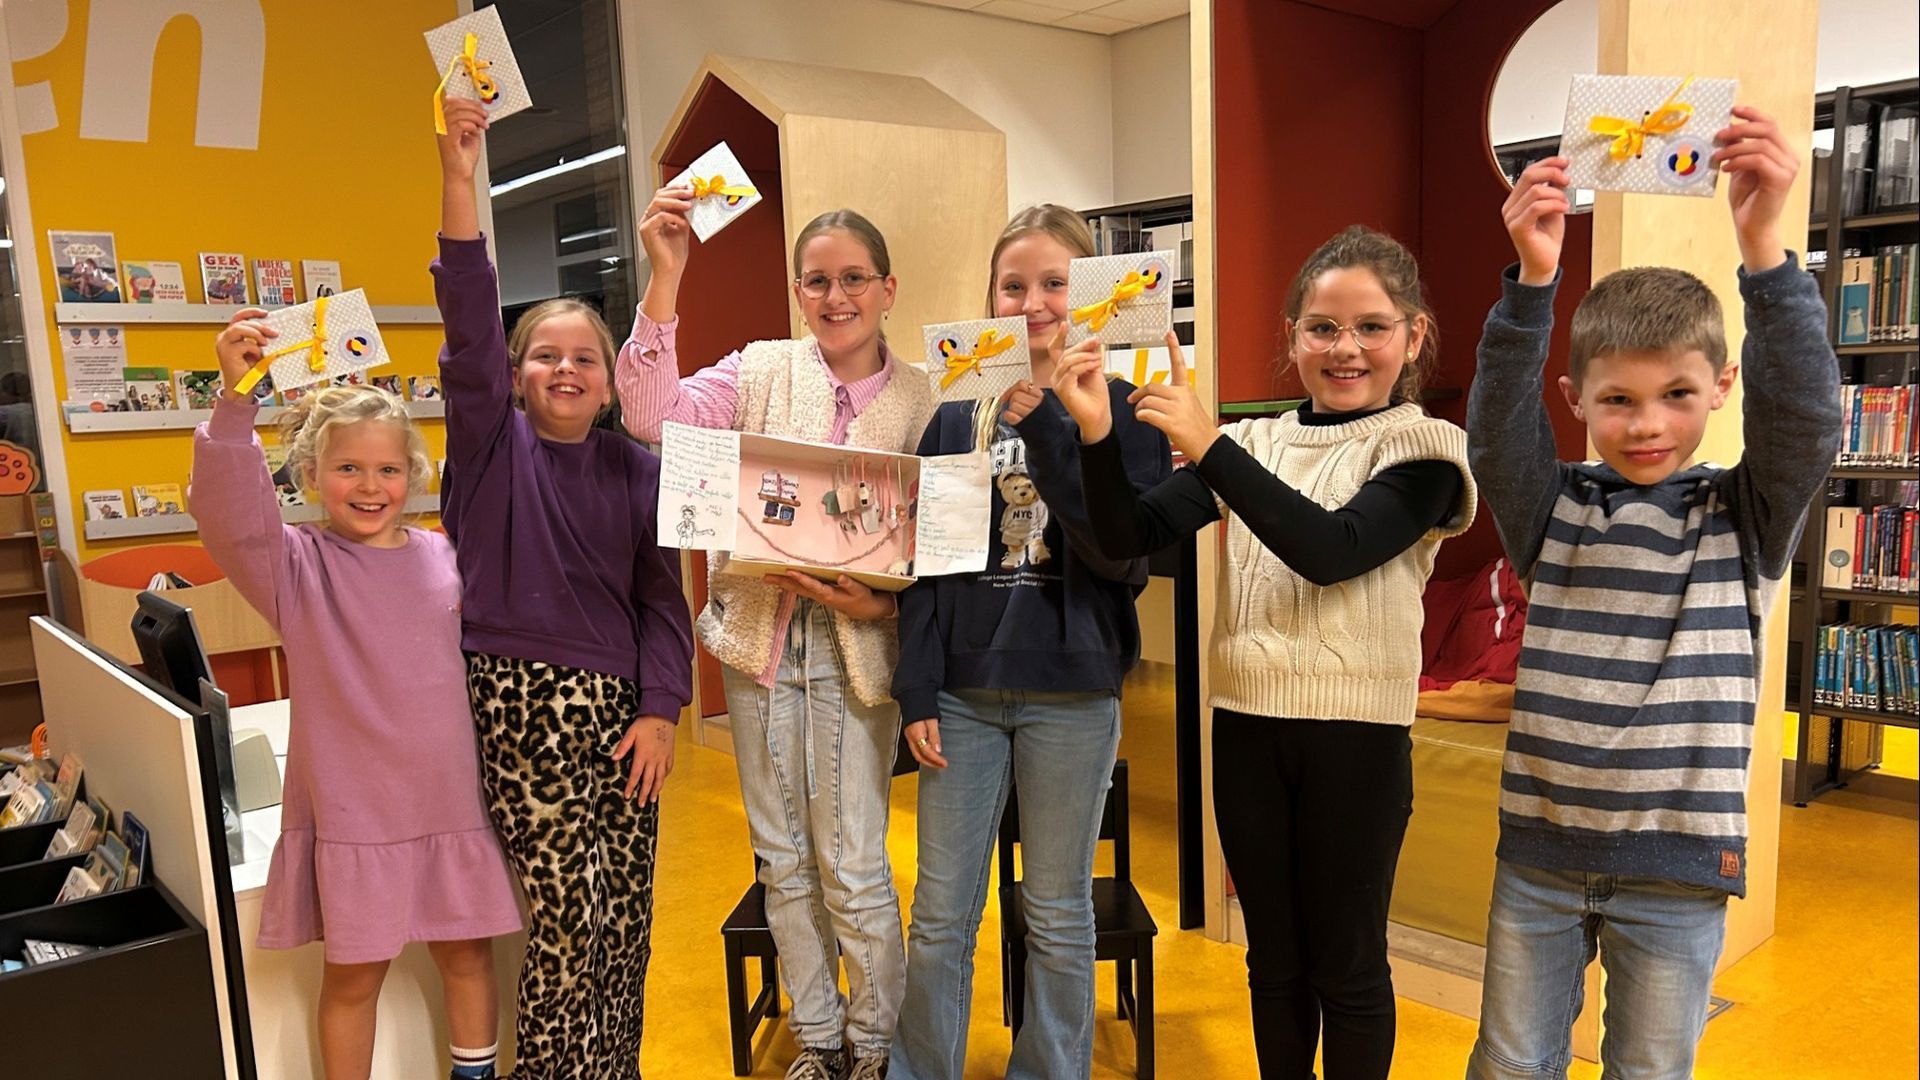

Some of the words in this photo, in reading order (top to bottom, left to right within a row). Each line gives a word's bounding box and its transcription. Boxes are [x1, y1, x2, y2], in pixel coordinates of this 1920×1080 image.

[205, 256, 240, 266] GEK
[257, 260, 284, 268] ANDERE
[1012, 510, 1033, 519] NYC
